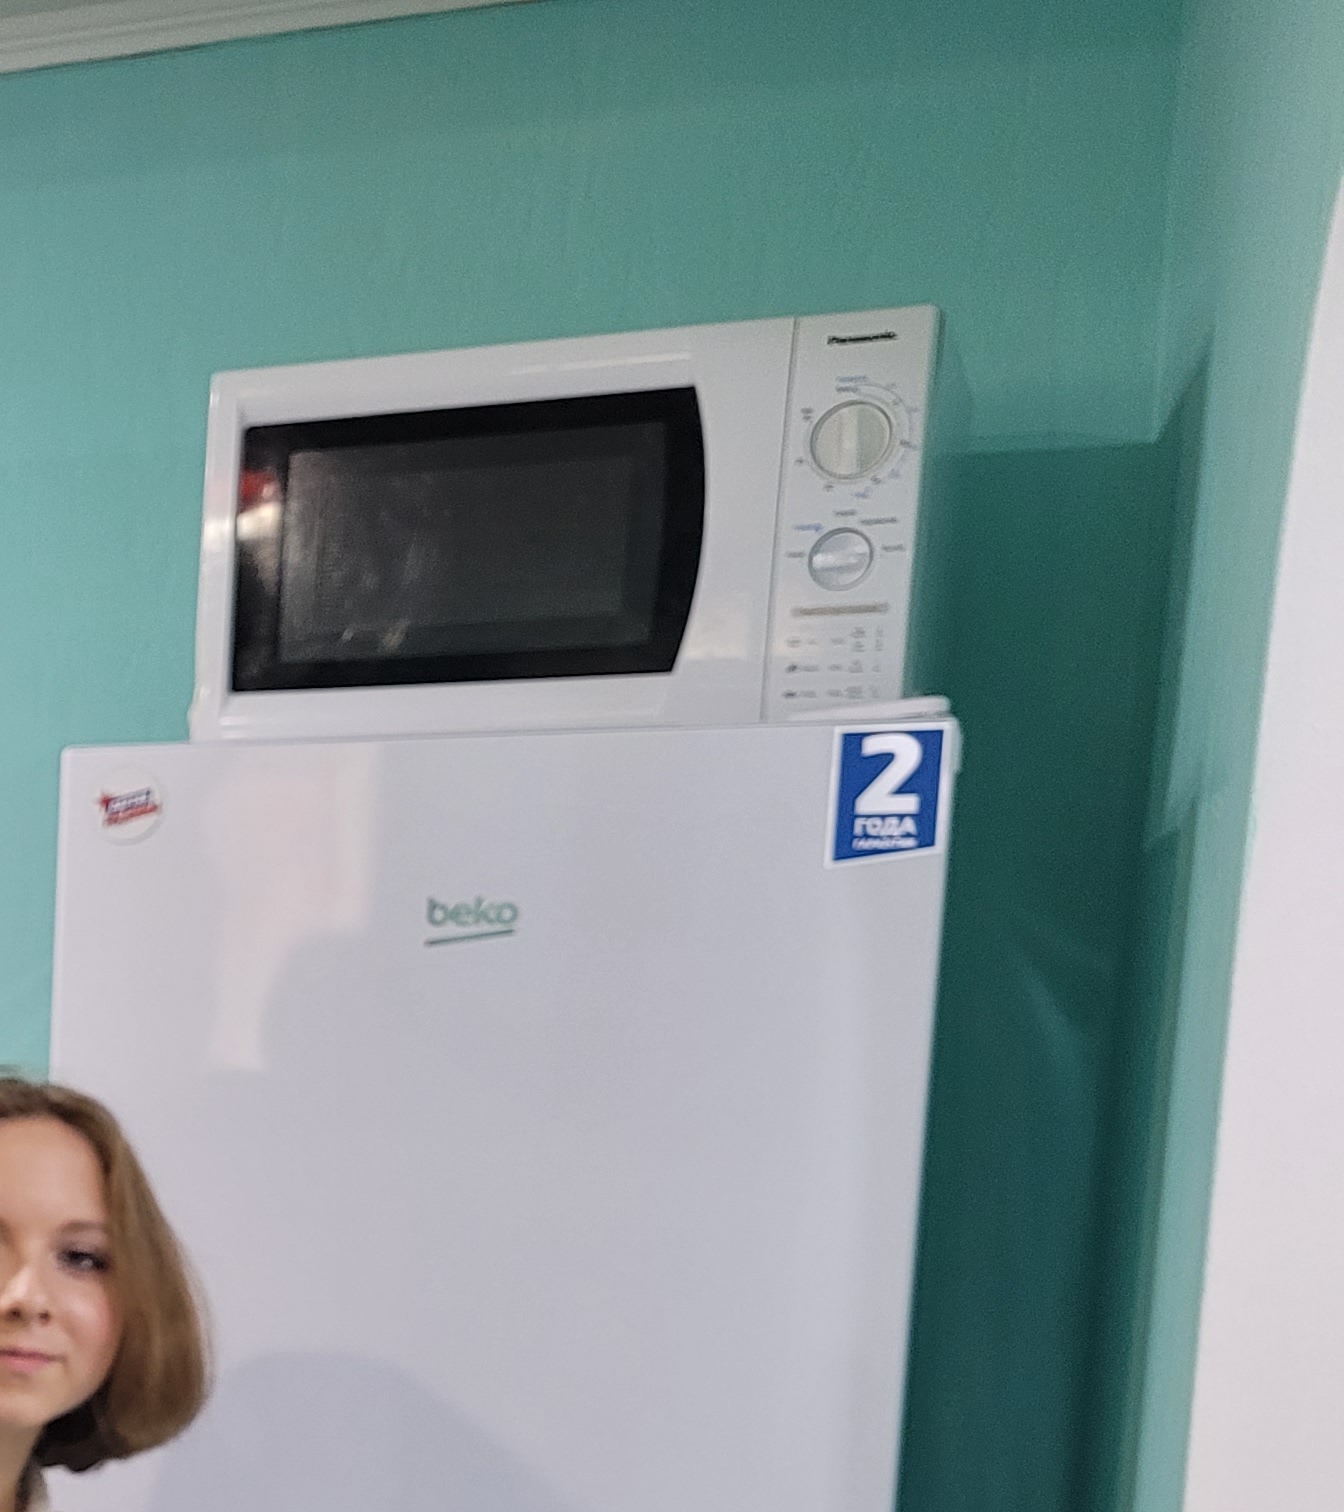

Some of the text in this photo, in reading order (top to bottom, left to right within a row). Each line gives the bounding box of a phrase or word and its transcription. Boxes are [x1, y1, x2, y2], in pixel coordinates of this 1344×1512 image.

[855, 732, 922, 815] 2
[853, 815, 918, 837] ГОДА
[426, 895, 519, 928] beko
